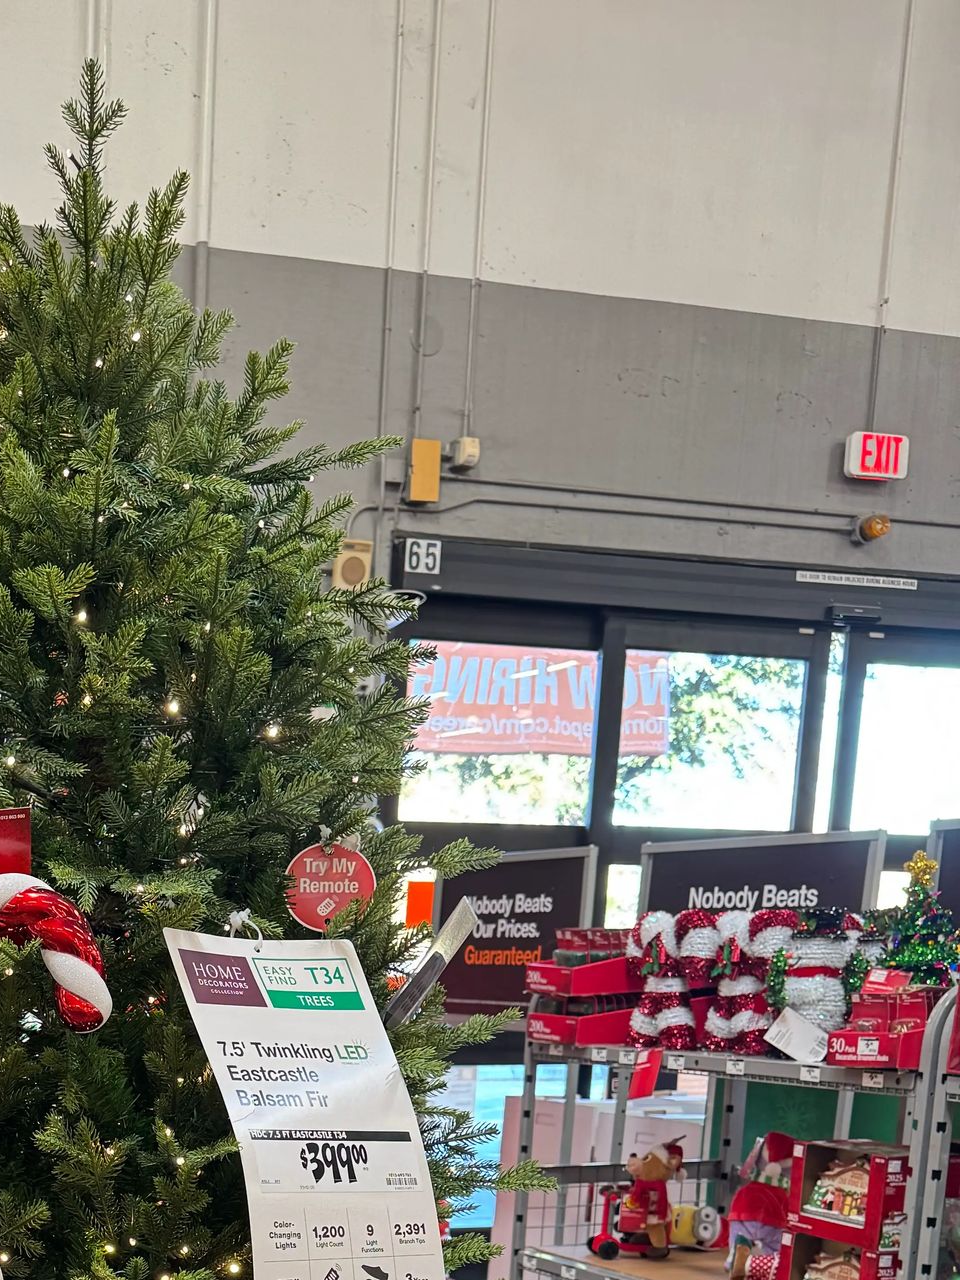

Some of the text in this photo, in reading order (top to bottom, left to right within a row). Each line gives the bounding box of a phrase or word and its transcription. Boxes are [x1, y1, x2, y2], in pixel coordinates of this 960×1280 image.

[859, 432, 904, 476] EXIT
[407, 539, 439, 572] 65
[304, 857, 357, 877] Try My
[299, 877, 359, 894] Remote
[467, 893, 553, 917] Nobody Beats
[689, 884, 818, 911] Nobody Beats
[472, 919, 496, 938] Our
[192, 962, 246, 981] HOME
[263, 966, 292, 976] EASY
[304, 967, 345, 985] T34
[198, 979, 249, 989] DECORATORS
[268, 976, 297, 986] FIND
[210, 988, 244, 996] COLLECTION
[296, 995, 335, 1007] TREES
[216, 1041, 369, 1063] 7.5' Twinkling LED
[829, 1037, 845, 1053] 30
[226, 1065, 320, 1083] Eastcastle
[236, 1089, 329, 1108] Balsam Fir
[250, 1130, 348, 1140] HDC FT EASTCASTLE T34
[273, 1221, 295, 1229] Color-
[312, 1225, 345, 1241] 1,200
[366, 1224, 374, 1236] 9
[394, 1223, 426, 1238] 2,391
[269, 1231, 301, 1240] Changing
[366, 1239, 378, 1247] Light
[275, 1241, 297, 1250] Lights
[316, 1241, 328, 1249] Light
